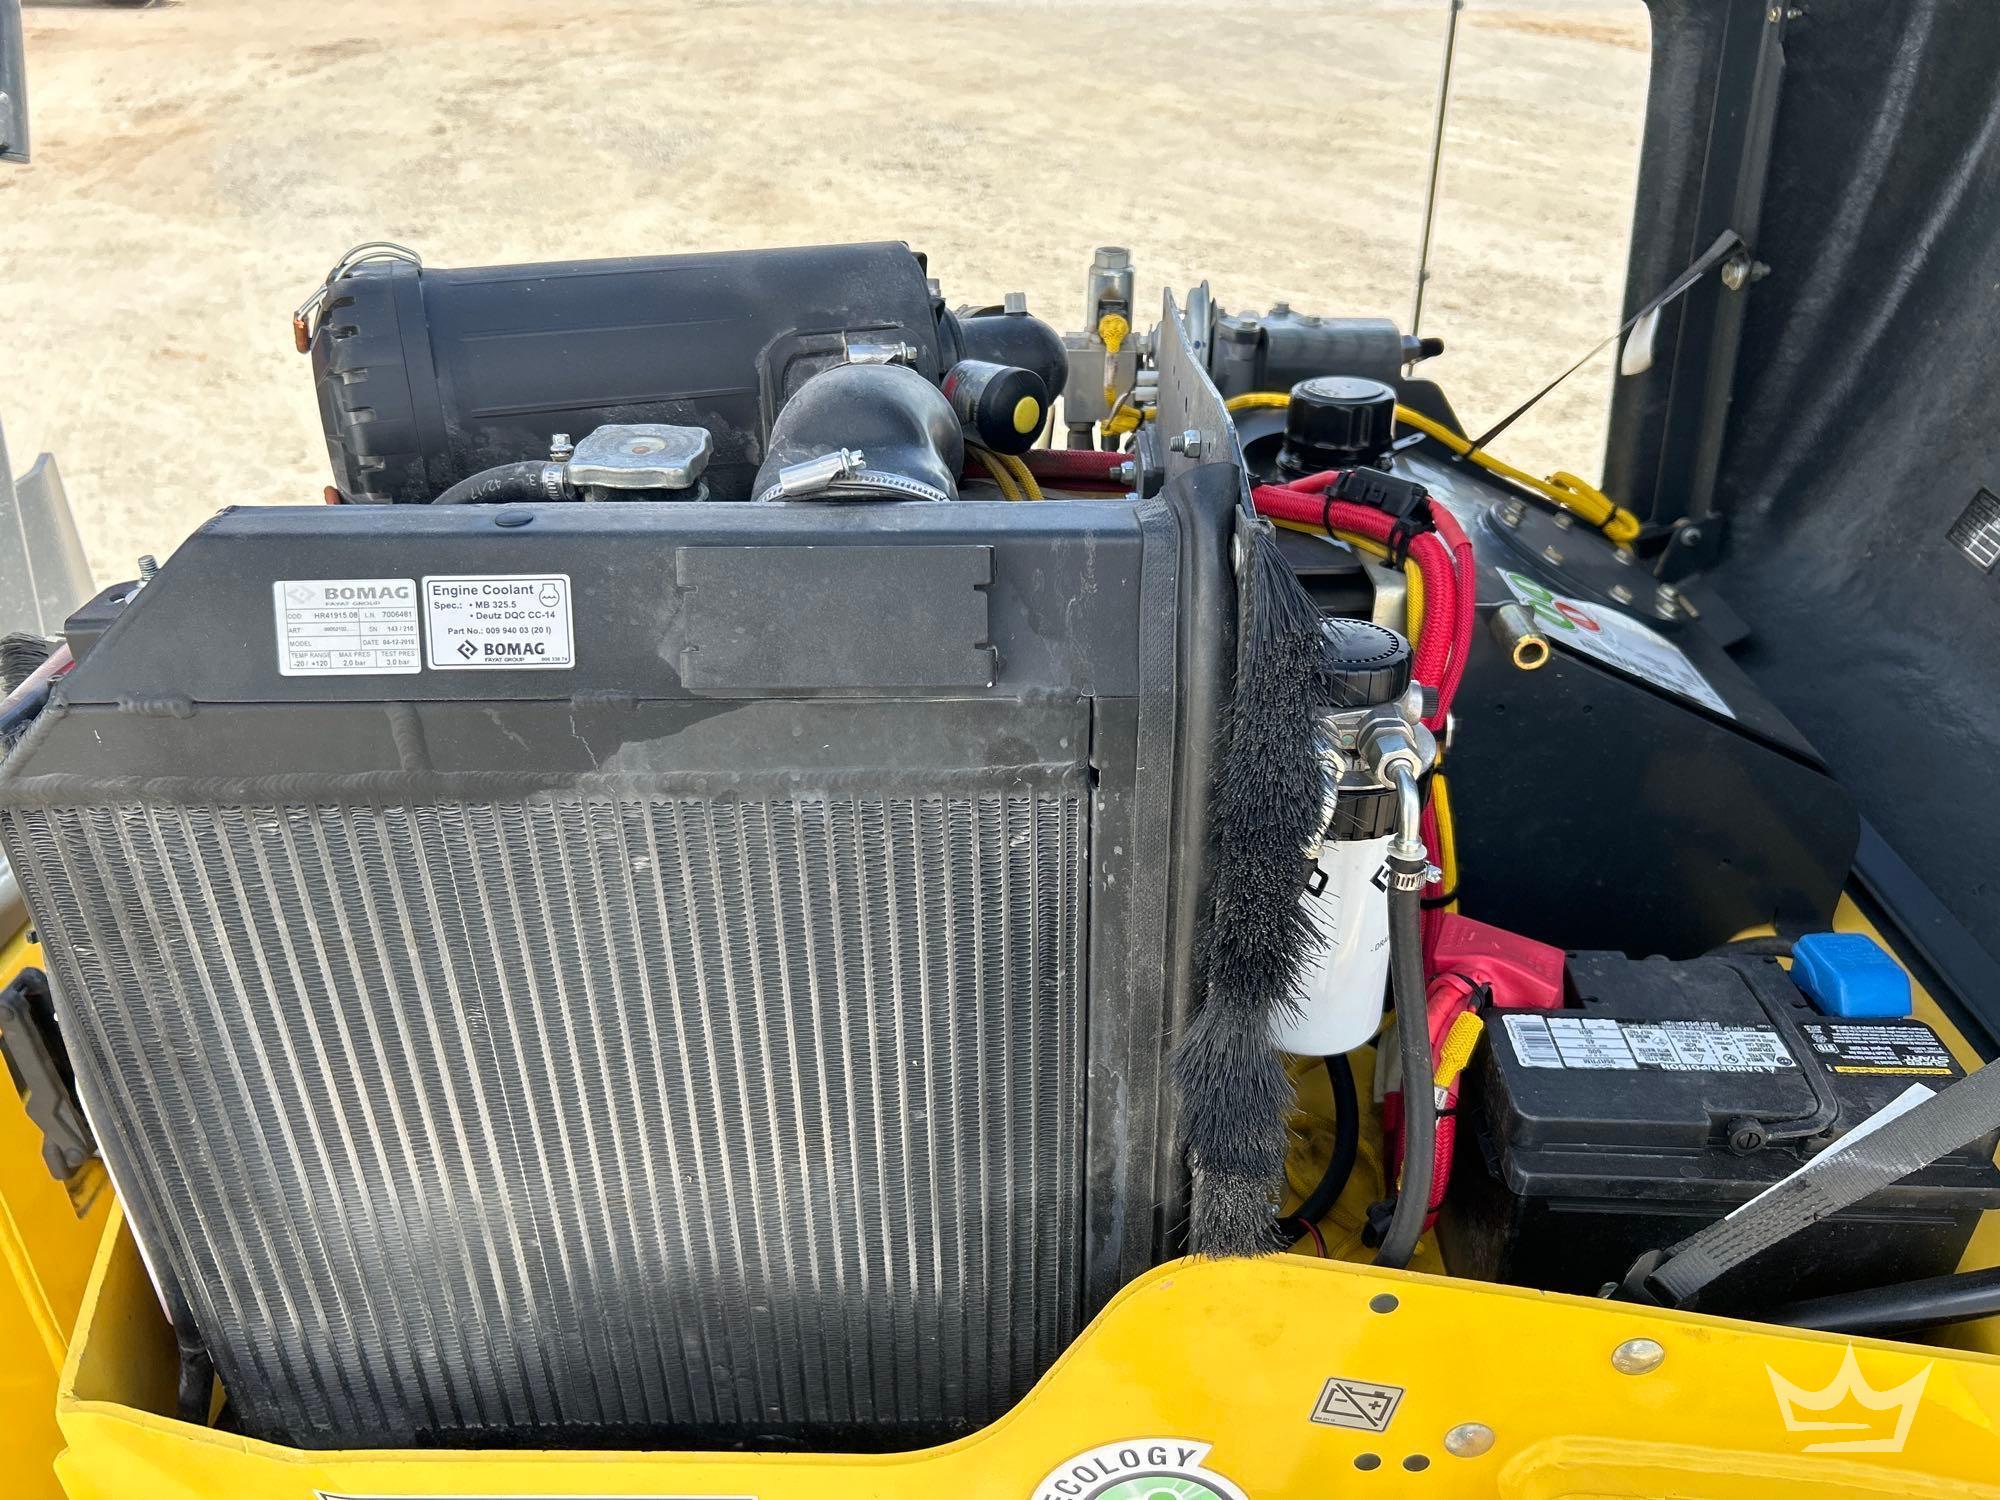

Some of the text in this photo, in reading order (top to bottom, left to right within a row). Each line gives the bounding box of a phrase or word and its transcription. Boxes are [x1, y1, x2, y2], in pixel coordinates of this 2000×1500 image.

[325, 587, 409, 600] BOMAG
[433, 584, 534, 597] Engine Coolant
[434, 602, 462, 610] Spec.:
[532, 626, 544, 635] (20
[484, 643, 545, 655] BOMAG
